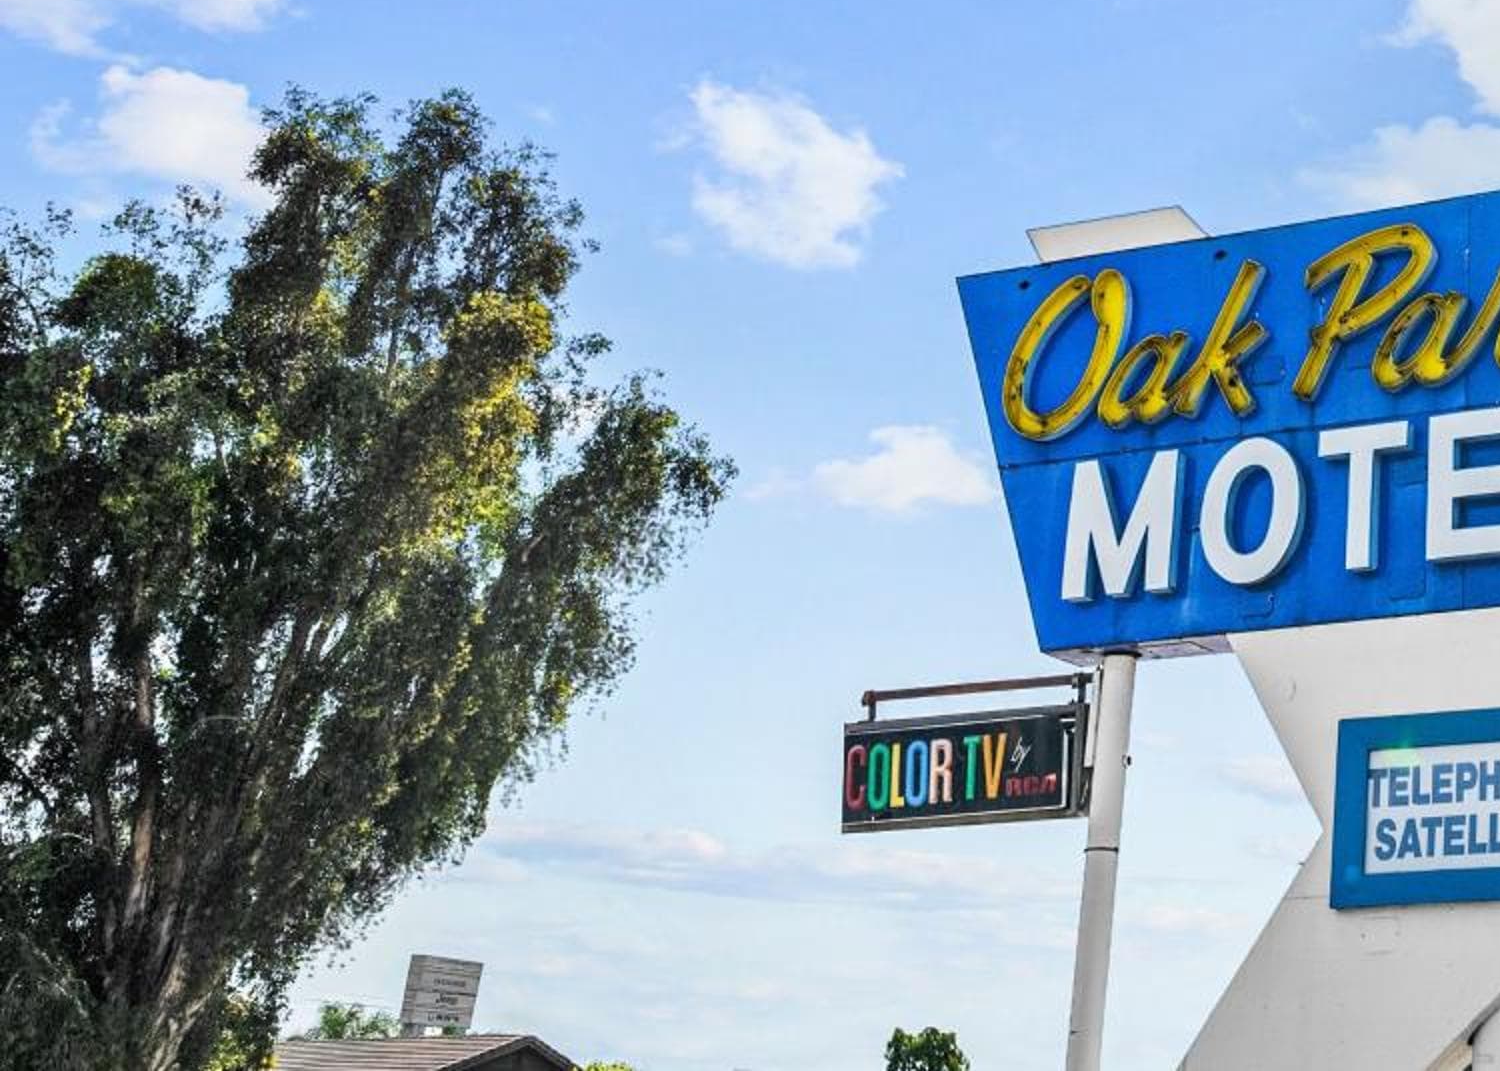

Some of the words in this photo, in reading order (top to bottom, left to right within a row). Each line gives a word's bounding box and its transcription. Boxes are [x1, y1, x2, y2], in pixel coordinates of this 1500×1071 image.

[1002, 258, 1270, 442] Oak
[846, 737, 953, 811] COLOR
[963, 732, 1008, 800] TV
[1009, 736, 1032, 773] by
